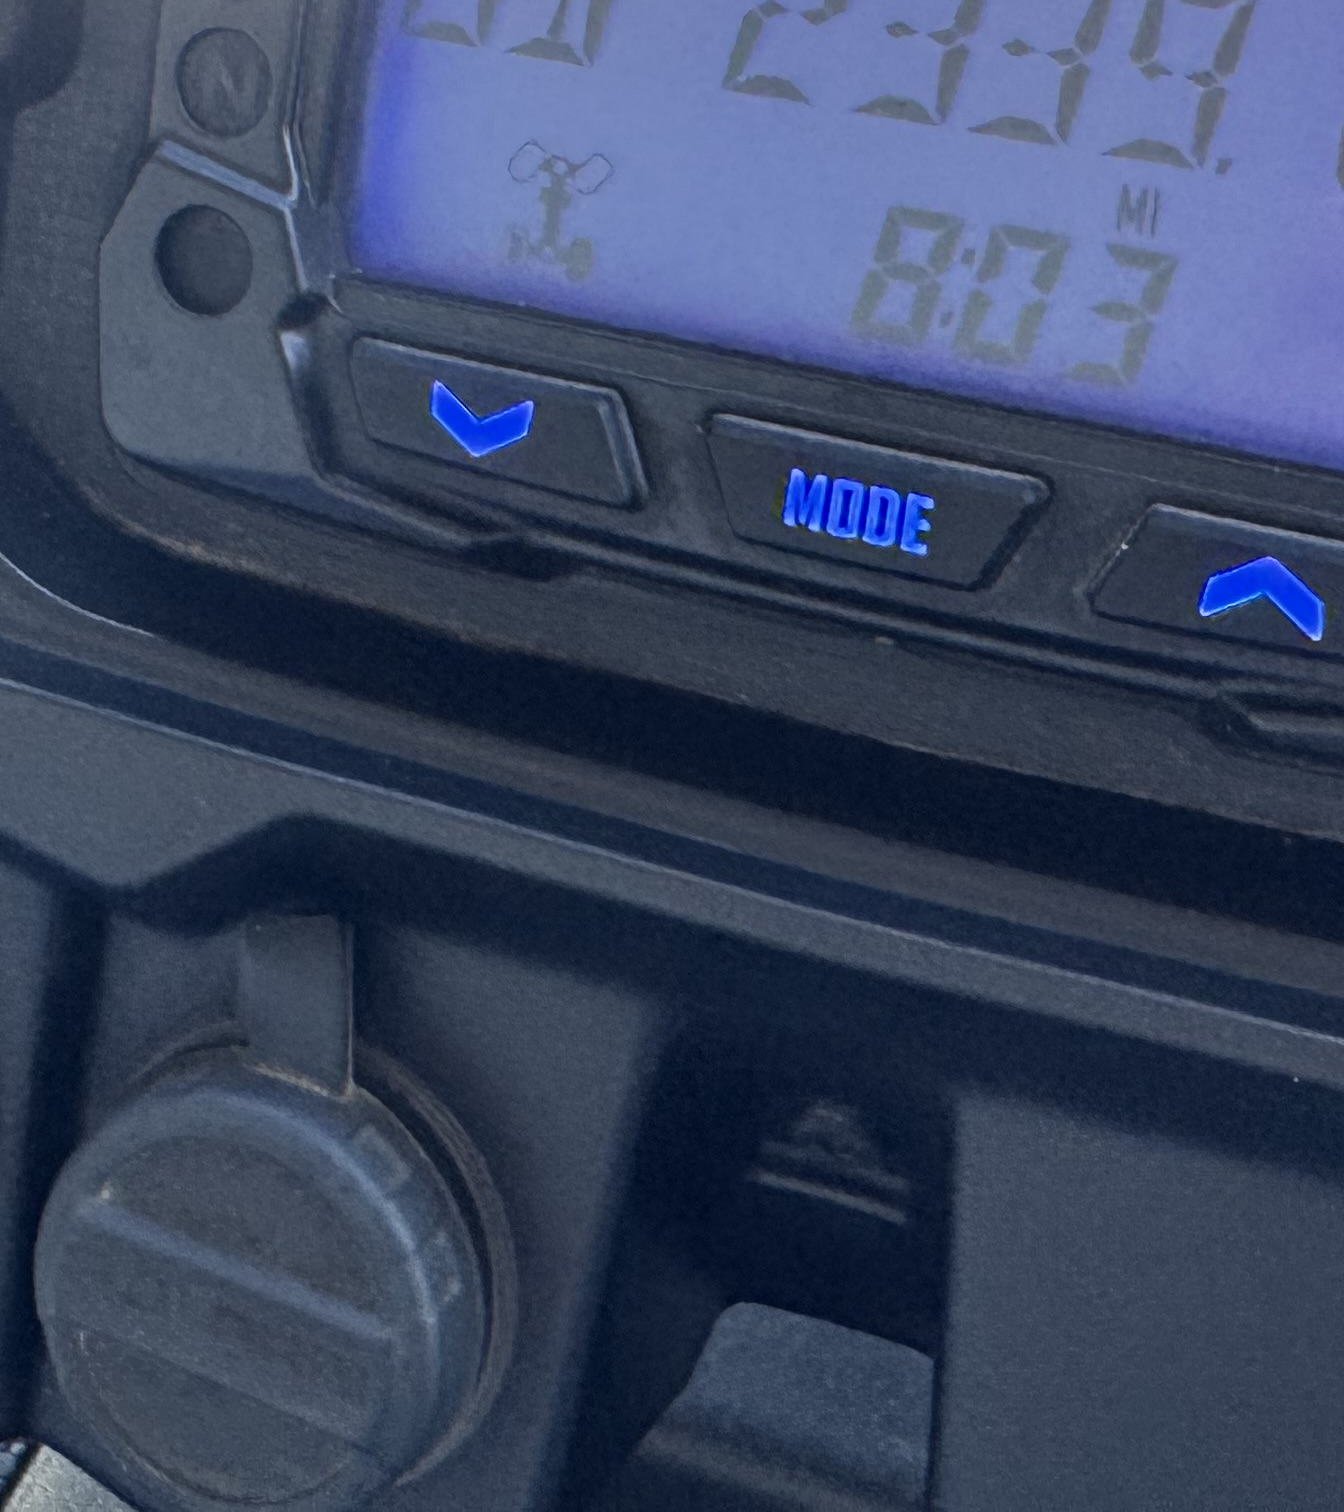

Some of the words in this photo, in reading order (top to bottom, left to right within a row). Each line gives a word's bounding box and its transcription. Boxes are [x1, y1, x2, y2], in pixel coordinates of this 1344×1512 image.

[1116, 182, 1160, 237] MI
[848, 205, 1179, 385] 8:03
[782, 467, 936, 557] MODE
